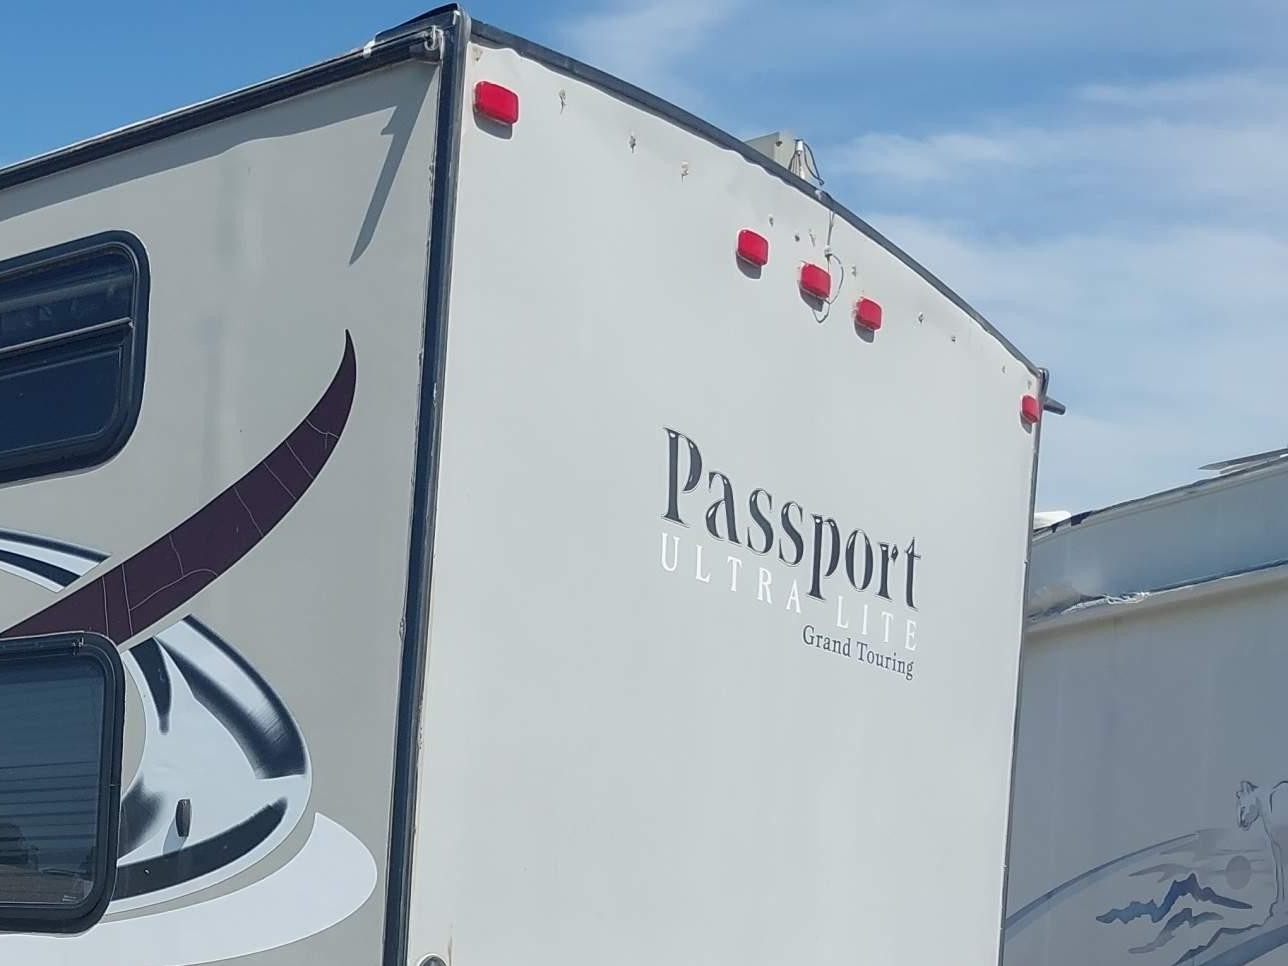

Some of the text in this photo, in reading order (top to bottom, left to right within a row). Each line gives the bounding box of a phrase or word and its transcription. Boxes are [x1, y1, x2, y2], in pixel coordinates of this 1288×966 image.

[661, 426, 922, 611] Passport
[660, 532, 918, 651] ULTRA LITE
[802, 624, 915, 681] Grand Touring
